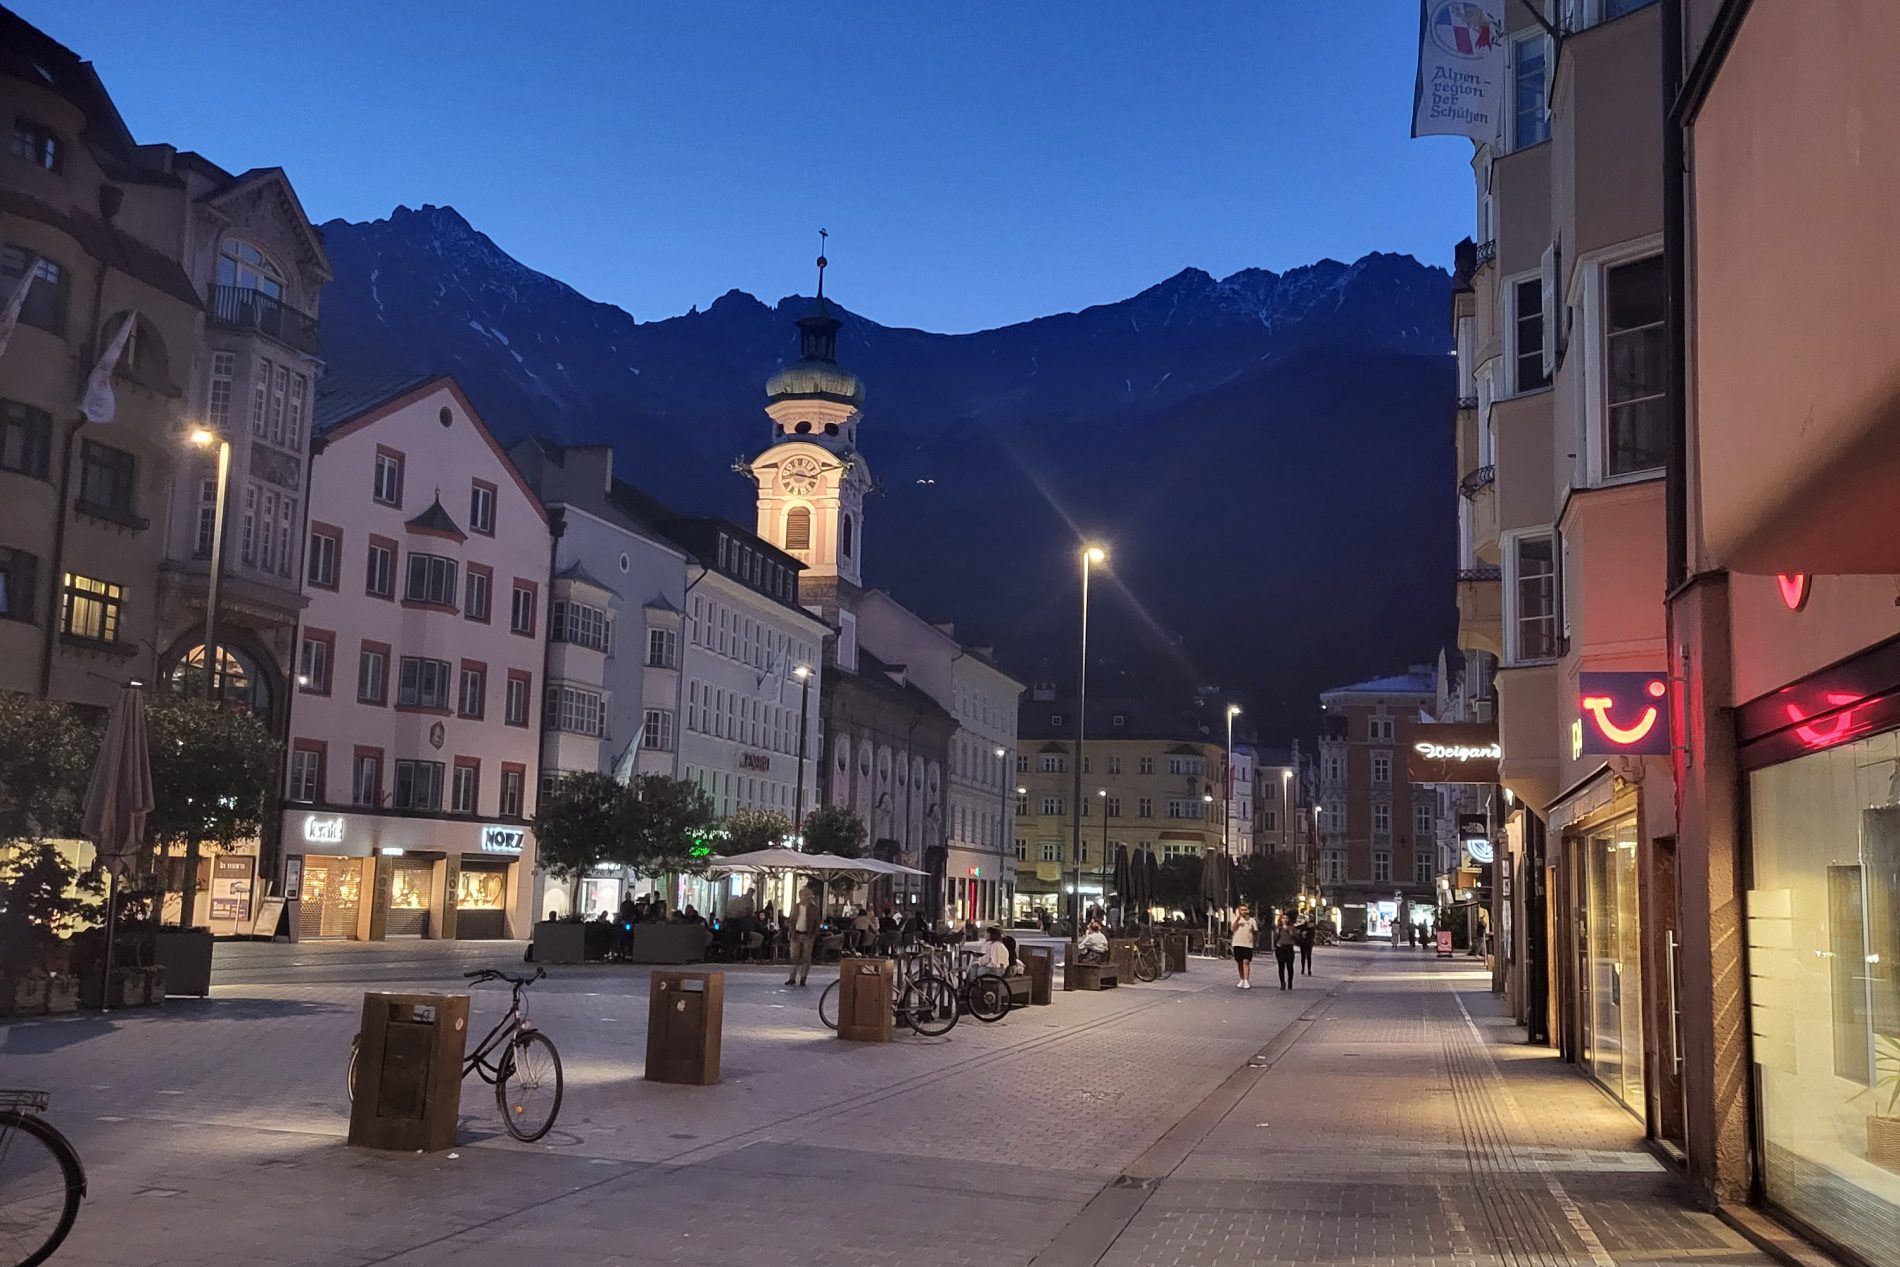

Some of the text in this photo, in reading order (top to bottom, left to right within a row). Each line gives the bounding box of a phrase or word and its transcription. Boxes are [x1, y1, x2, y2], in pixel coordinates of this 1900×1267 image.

[1434, 83, 1484, 98] region
[1415, 743, 1502, 762] Weigand
[485, 829, 525, 850] NORZ
